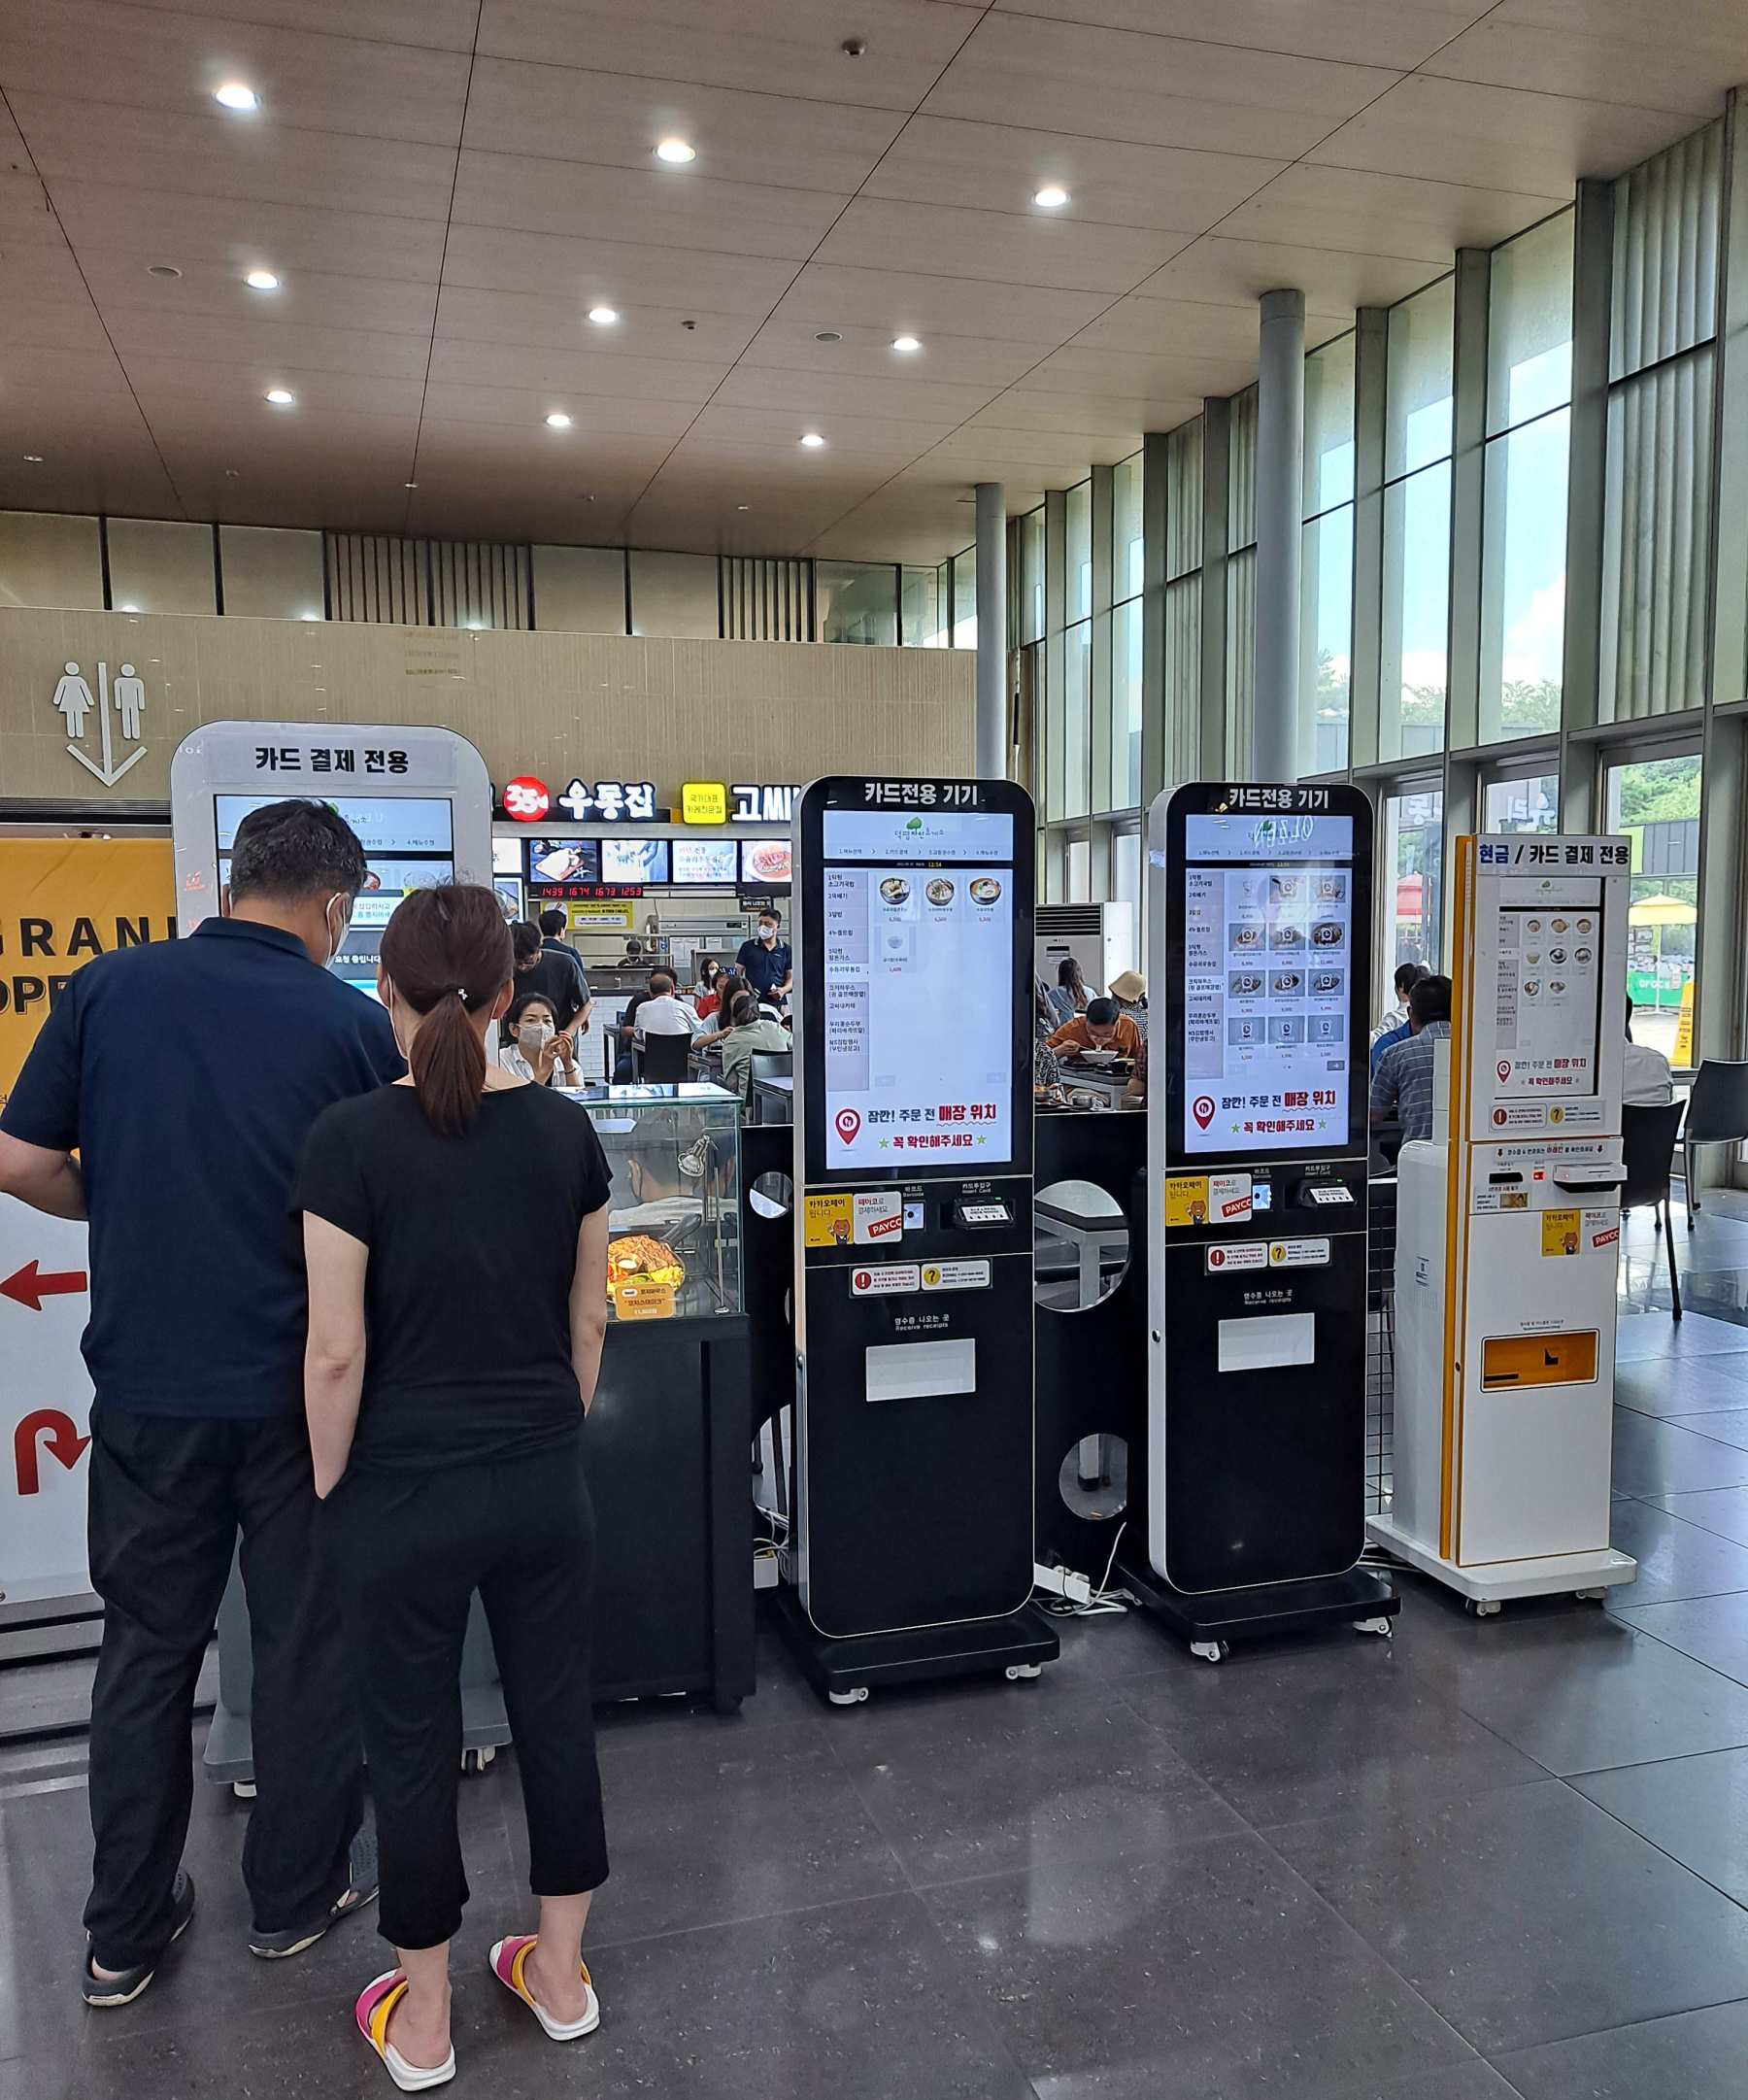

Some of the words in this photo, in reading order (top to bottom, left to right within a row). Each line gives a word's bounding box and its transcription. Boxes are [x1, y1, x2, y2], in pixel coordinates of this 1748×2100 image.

[255, 747, 301, 771] 카드
[310, 748, 355, 773] 결제
[364, 750, 409, 774] 전용
[559, 781, 654, 820] 우동집
[864, 782, 937, 805] 카드전용
[944, 785, 978, 806] 기기
[1229, 788, 1293, 808] 카드전용
[1298, 790, 1328, 809] 기기
[1479, 844, 1509, 864] 현금
[1514, 844, 1525, 864] /
[1530, 844, 1560, 864] 카드
[1564, 845, 1594, 864] 결제
[1599, 845, 1630, 865] 전용
[0, 916, 179, 957] RAN
[1221, 1097, 1246, 1109] 잠깐!
[1249, 1096, 1269, 1107] 주문
[1272, 1095, 1282, 1106] 전
[1284, 1091, 1309, 1106] 매장
[1312, 1090, 1336, 1105] 위치
[867, 1109, 895, 1123] 잠깐!
[899, 1108, 922, 1122] 주문
[924, 1107, 935, 1122] 전
[938, 1104, 966, 1122] 매장
[970, 1102, 996, 1120] 위치
[1243, 1121, 1253, 1134] 꼭
[1256, 1118, 1315, 1133] 확인해주세요
[892, 1135, 904, 1149] 꼭
[907, 1134, 973, 1149] 확인해주세요
